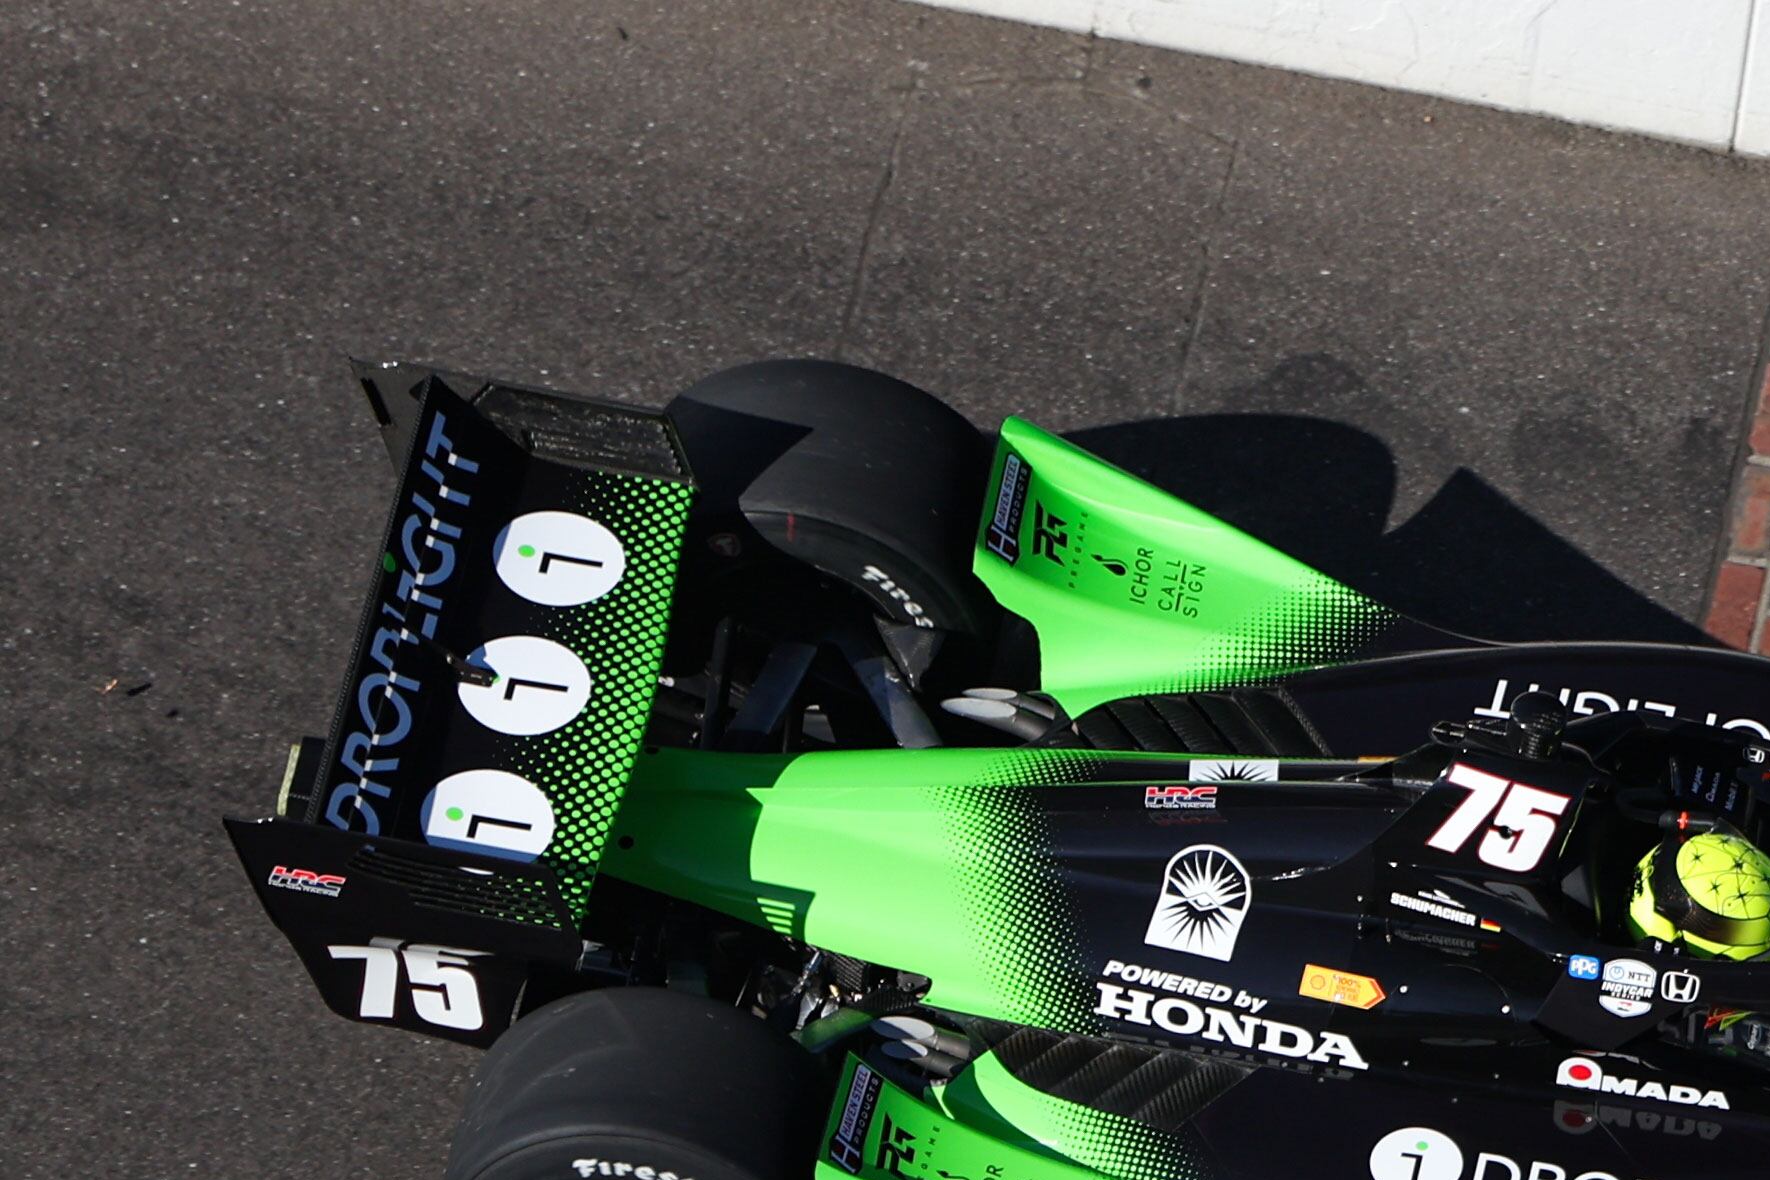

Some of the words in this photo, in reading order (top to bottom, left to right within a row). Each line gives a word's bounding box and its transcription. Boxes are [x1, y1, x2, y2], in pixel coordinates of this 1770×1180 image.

[861, 565, 934, 628] Fires
[1129, 547, 1154, 605] ICHOR
[1157, 560, 1181, 611] CALL
[1182, 564, 1207, 618] SIGN
[1426, 763, 1571, 873] 75
[1390, 892, 1477, 927] SCHUMACHER
[327, 943, 484, 1031] 75
[1102, 959, 1233, 1002] POWERED
[1233, 990, 1268, 1015] by
[1571, 958, 1597, 977] PPG
[1601, 981, 1654, 999] INDYCAR
[1628, 971, 1651, 982] NTT
[1093, 982, 1369, 1071] HONDA
[841, 1099, 858, 1137] HAVEN
[852, 1069, 869, 1101] STEEL
[853, 1076, 880, 1145] PRODUCTS
[1556, 1057, 1730, 1110] AMADA
